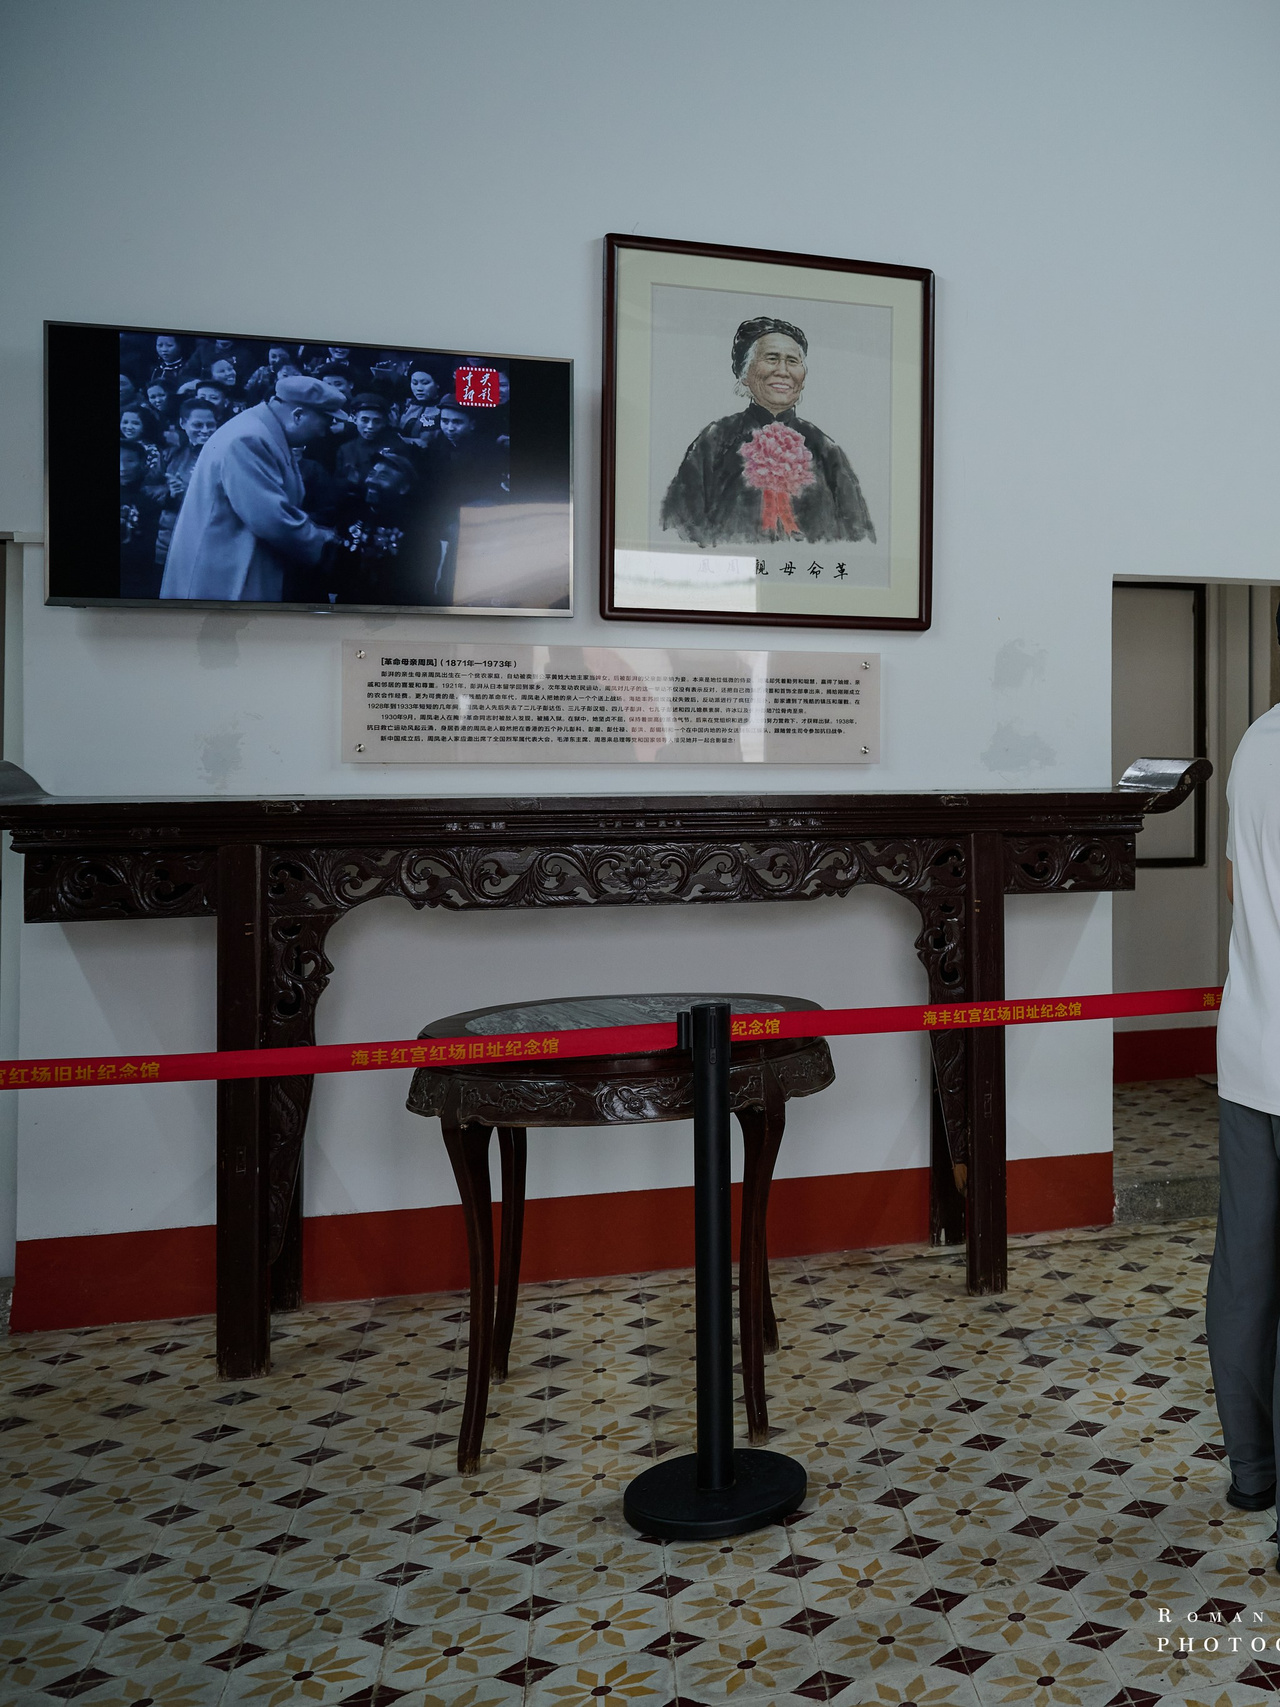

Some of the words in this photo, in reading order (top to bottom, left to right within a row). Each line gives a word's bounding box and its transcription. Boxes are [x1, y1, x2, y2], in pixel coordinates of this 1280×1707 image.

[922, 1001, 1082, 1026] 海丰红宫红场旧址纪念馆
[732, 1018, 781, 1036] 纪念馆
[351, 1038, 560, 1067] 海丰红宫红场旧址纪念馆
[0, 1060, 160, 1085] 红场旧址纪念馆
